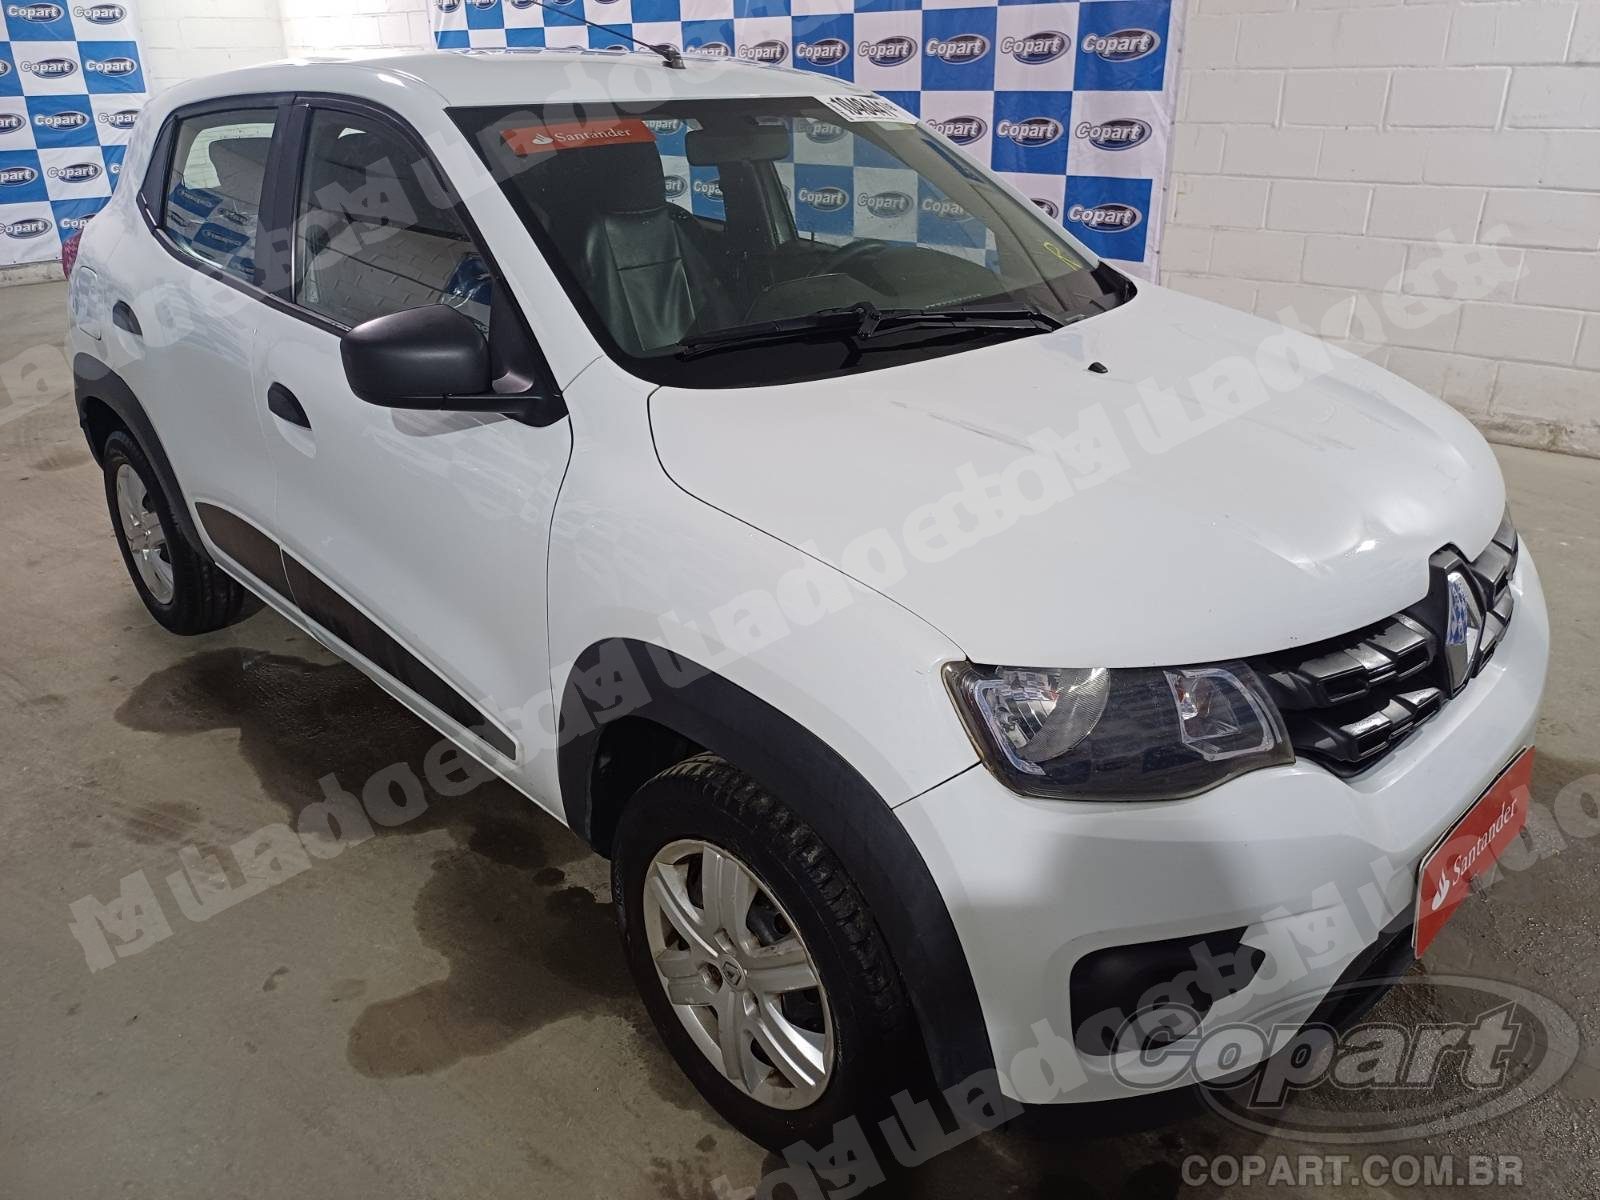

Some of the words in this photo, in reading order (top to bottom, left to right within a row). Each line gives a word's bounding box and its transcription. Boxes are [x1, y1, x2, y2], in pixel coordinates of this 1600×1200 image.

[8, 5, 58, 20] Copart
[73, 6, 121, 20] Copart
[738, 43, 782, 61] Copart
[796, 42, 843, 61] Copart
[858, 40, 910, 60] Copart
[926, 38, 983, 57] Copart
[1000, 35, 1060, 57] Copart
[1081, 32, 1150, 54] Copart
[20, 60, 70, 75] Copart
[86, 60, 132, 75] Copart
[34, 113, 82, 128] Copart
[98, 112, 137, 126] Copar
[554, 127, 632, 142] Santander
[997, 119, 1054, 139] Copart
[1075, 121, 1140, 144] Copart
[0, 169, 32, 183] part
[47, 165, 96, 179] Copart
[799, 187, 843, 206] Copart
[857, 193, 905, 212] Copart
[1067, 204, 1132, 227] Copart
[1452, 797, 1518, 886] Santander
